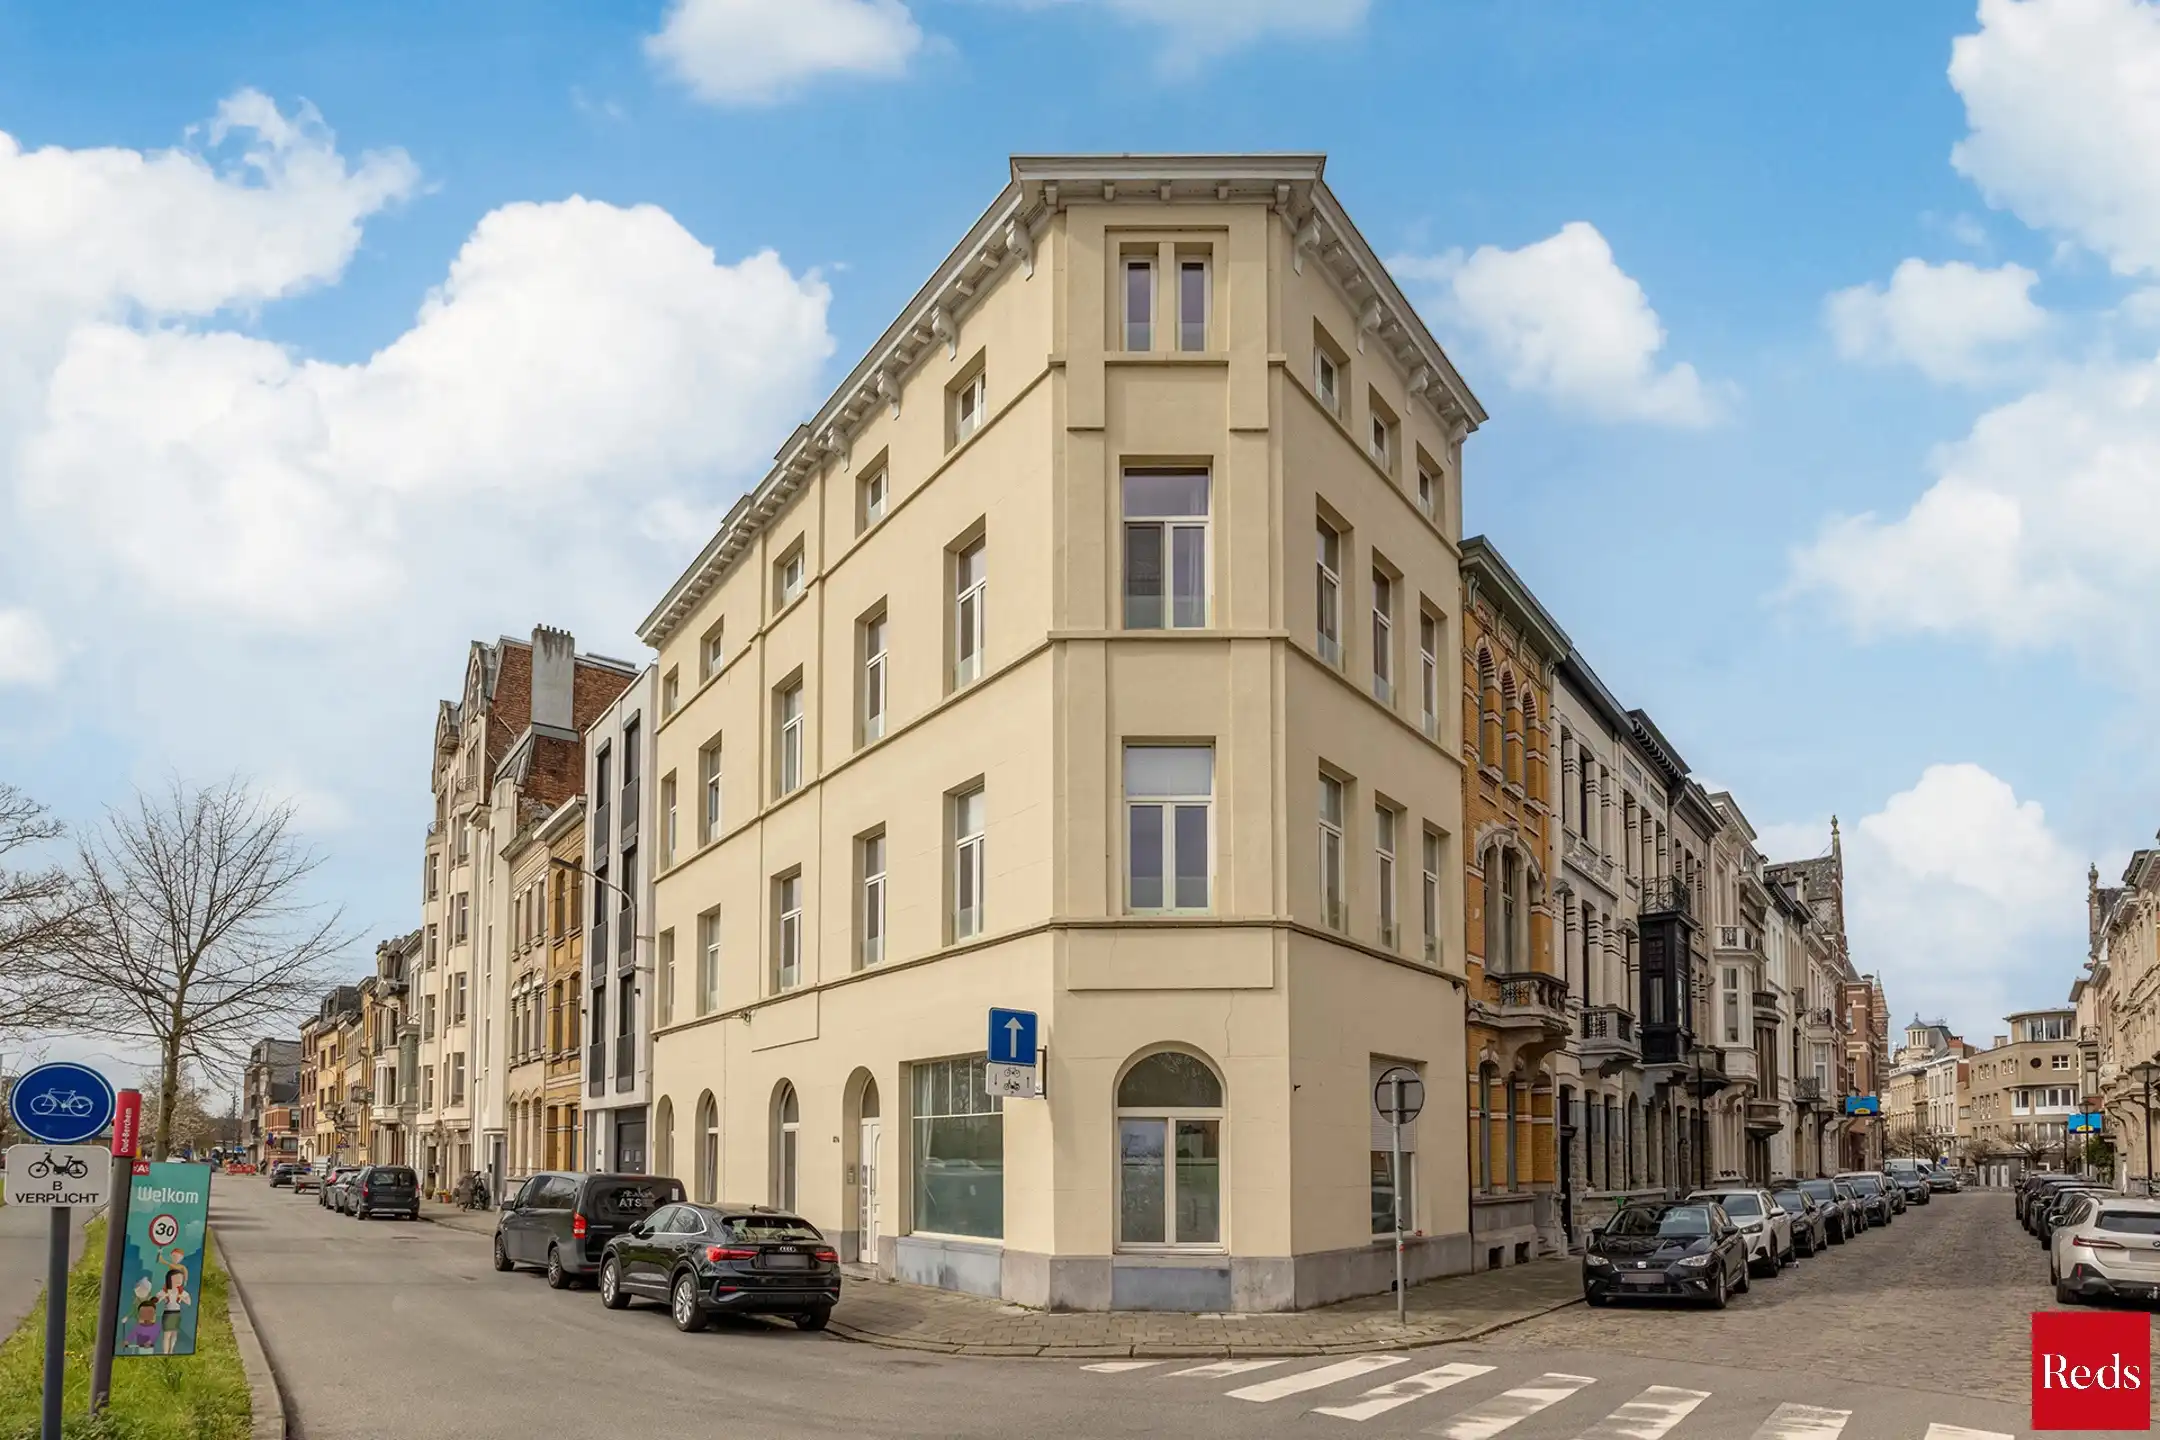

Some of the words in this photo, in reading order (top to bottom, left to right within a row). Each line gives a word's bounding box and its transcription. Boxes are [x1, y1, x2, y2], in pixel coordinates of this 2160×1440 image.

[120, 1107, 133, 1153] Oud-Berchem
[52, 1180, 63, 1191] B
[15, 1193, 99, 1203] VERPLICHT
[137, 1186, 199, 1204] Welkom
[619, 1198, 642, 1207] ATS
[155, 1222, 175, 1237] 30
